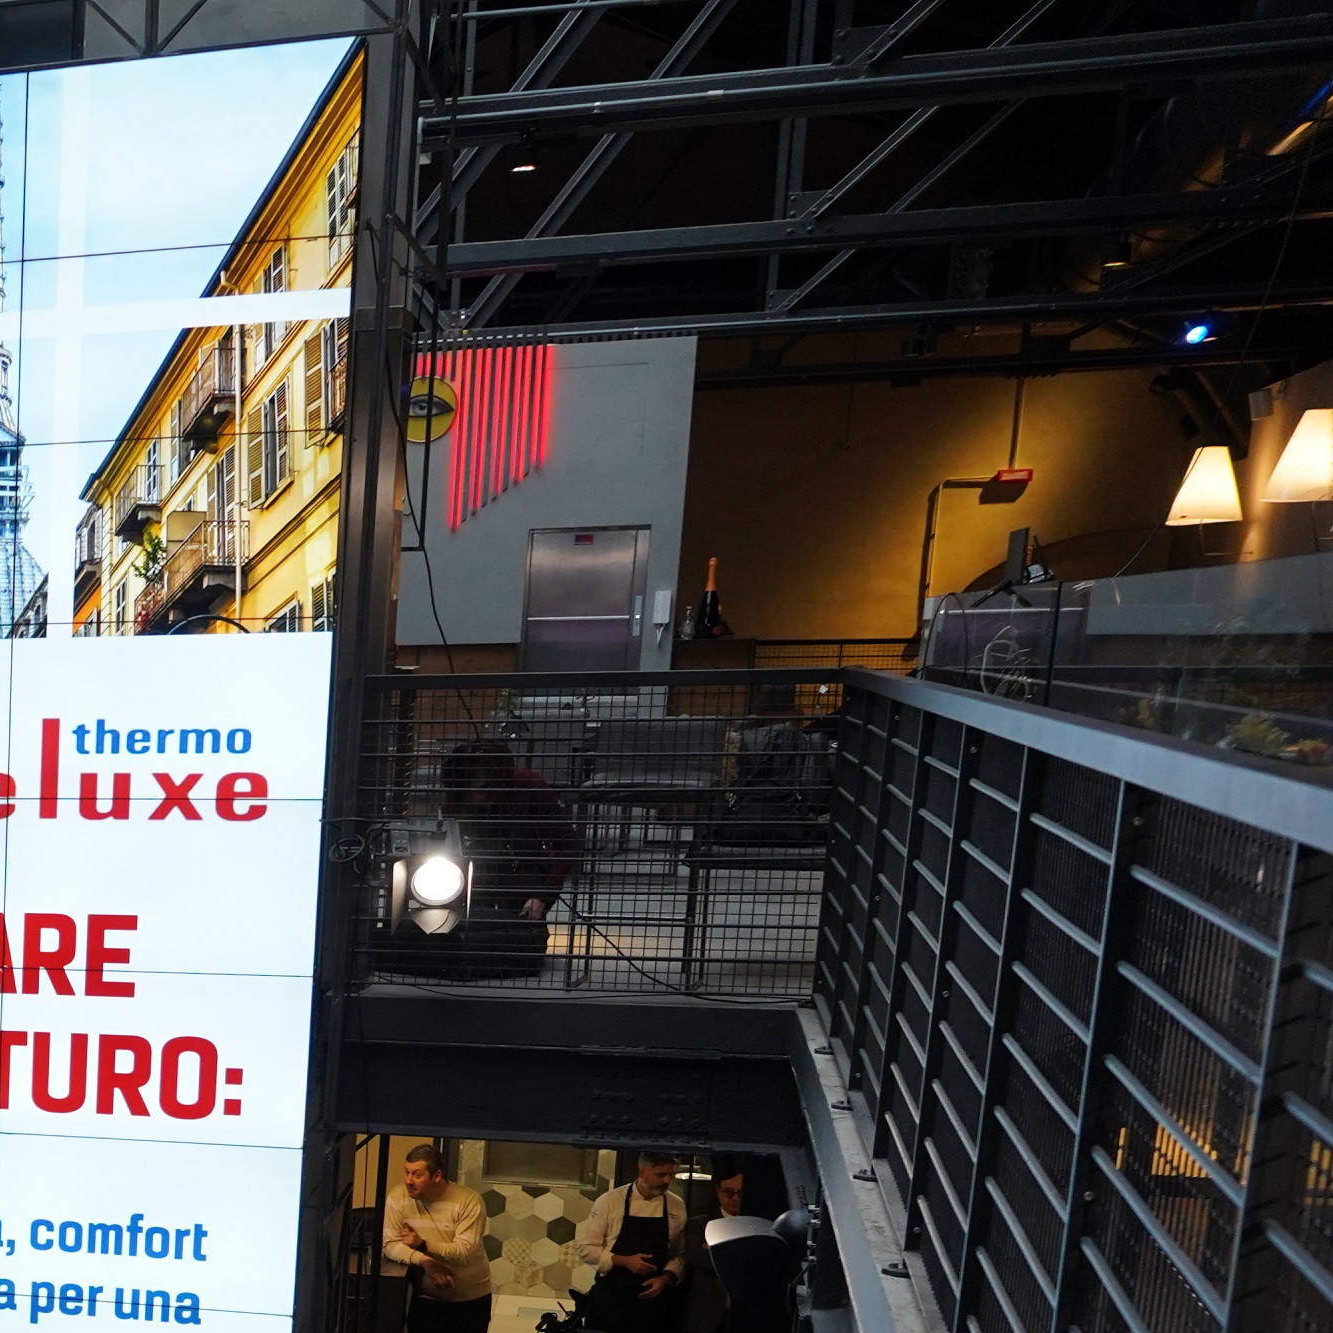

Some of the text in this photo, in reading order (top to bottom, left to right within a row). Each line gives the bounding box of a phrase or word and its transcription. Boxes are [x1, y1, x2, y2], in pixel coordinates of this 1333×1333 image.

[72, 718, 253, 755] thermo
[29, 1213, 209, 1262] comfort
[29, 1280, 104, 1324] per
[114, 1286, 202, 1326] una
